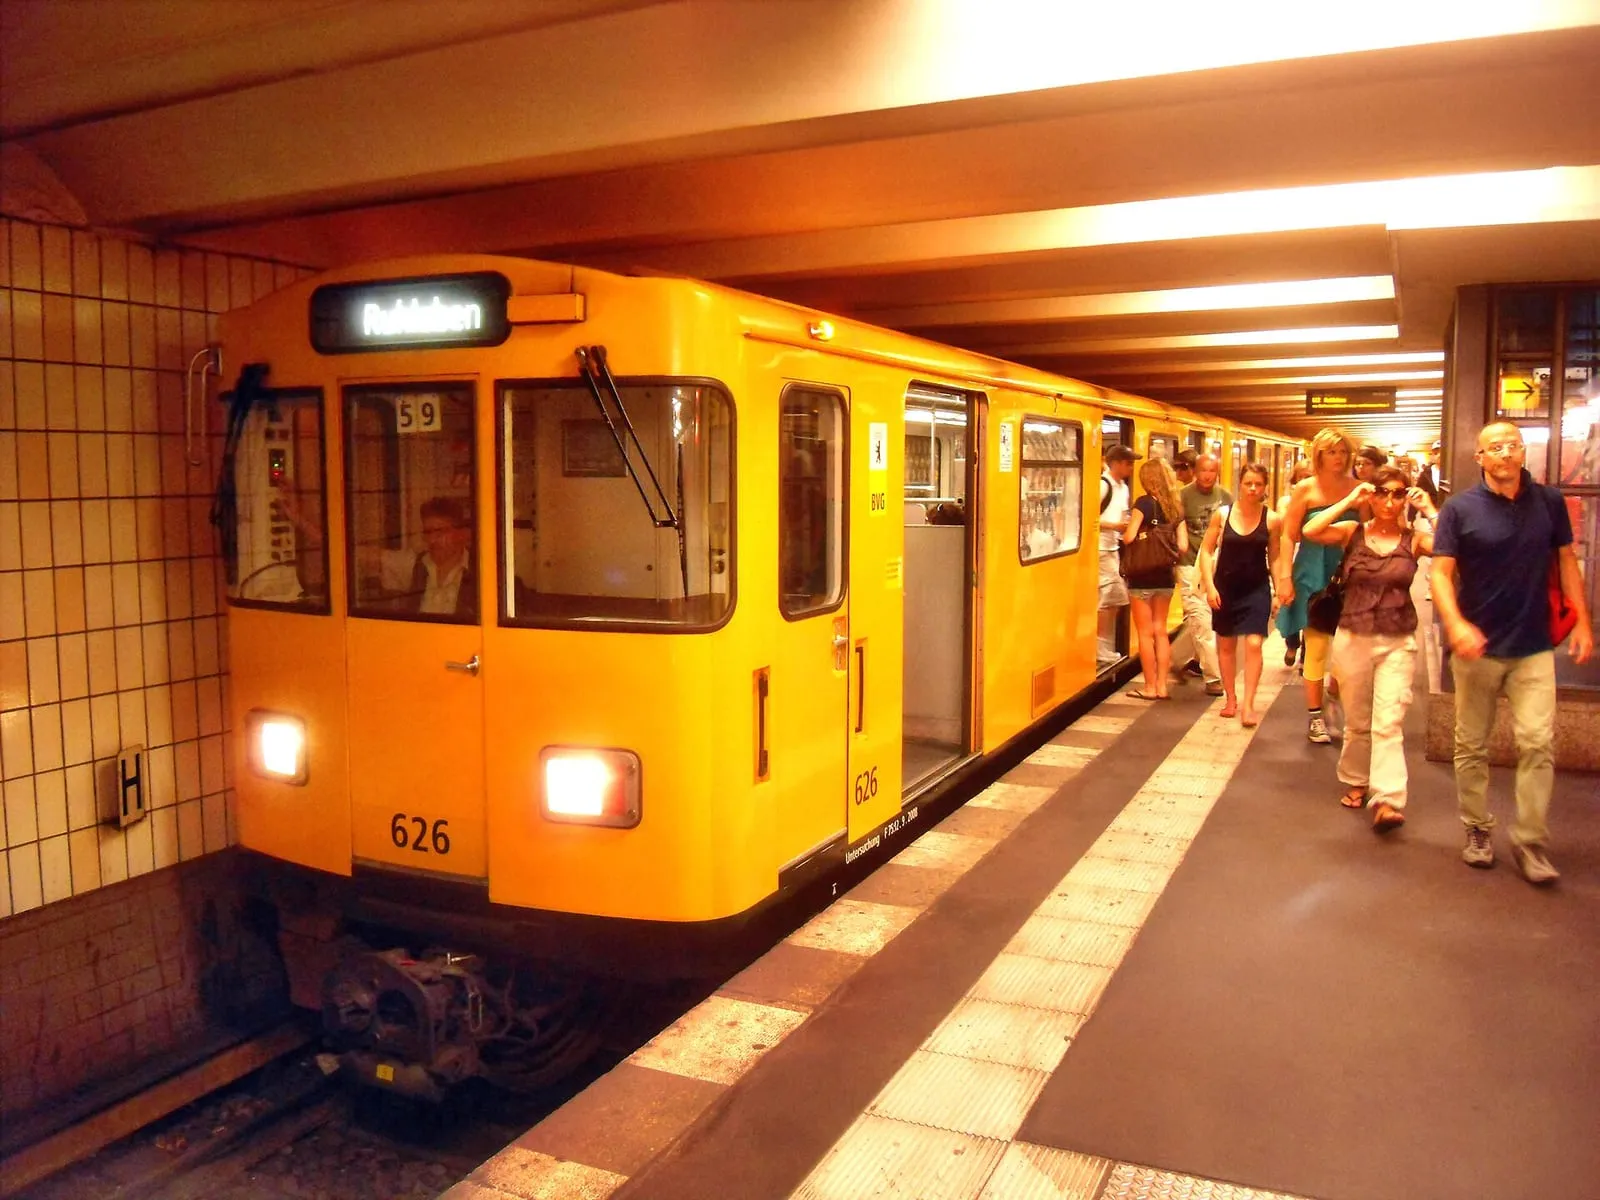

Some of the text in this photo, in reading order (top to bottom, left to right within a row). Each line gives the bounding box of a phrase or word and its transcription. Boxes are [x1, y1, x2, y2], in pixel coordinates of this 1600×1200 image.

[400, 401, 435, 428] 59
[871, 493, 885, 511] BVG
[120, 753, 142, 817] H
[855, 766, 878, 806] 626
[391, 813, 450, 855] 626
[845, 833, 881, 865] Untersuchung
